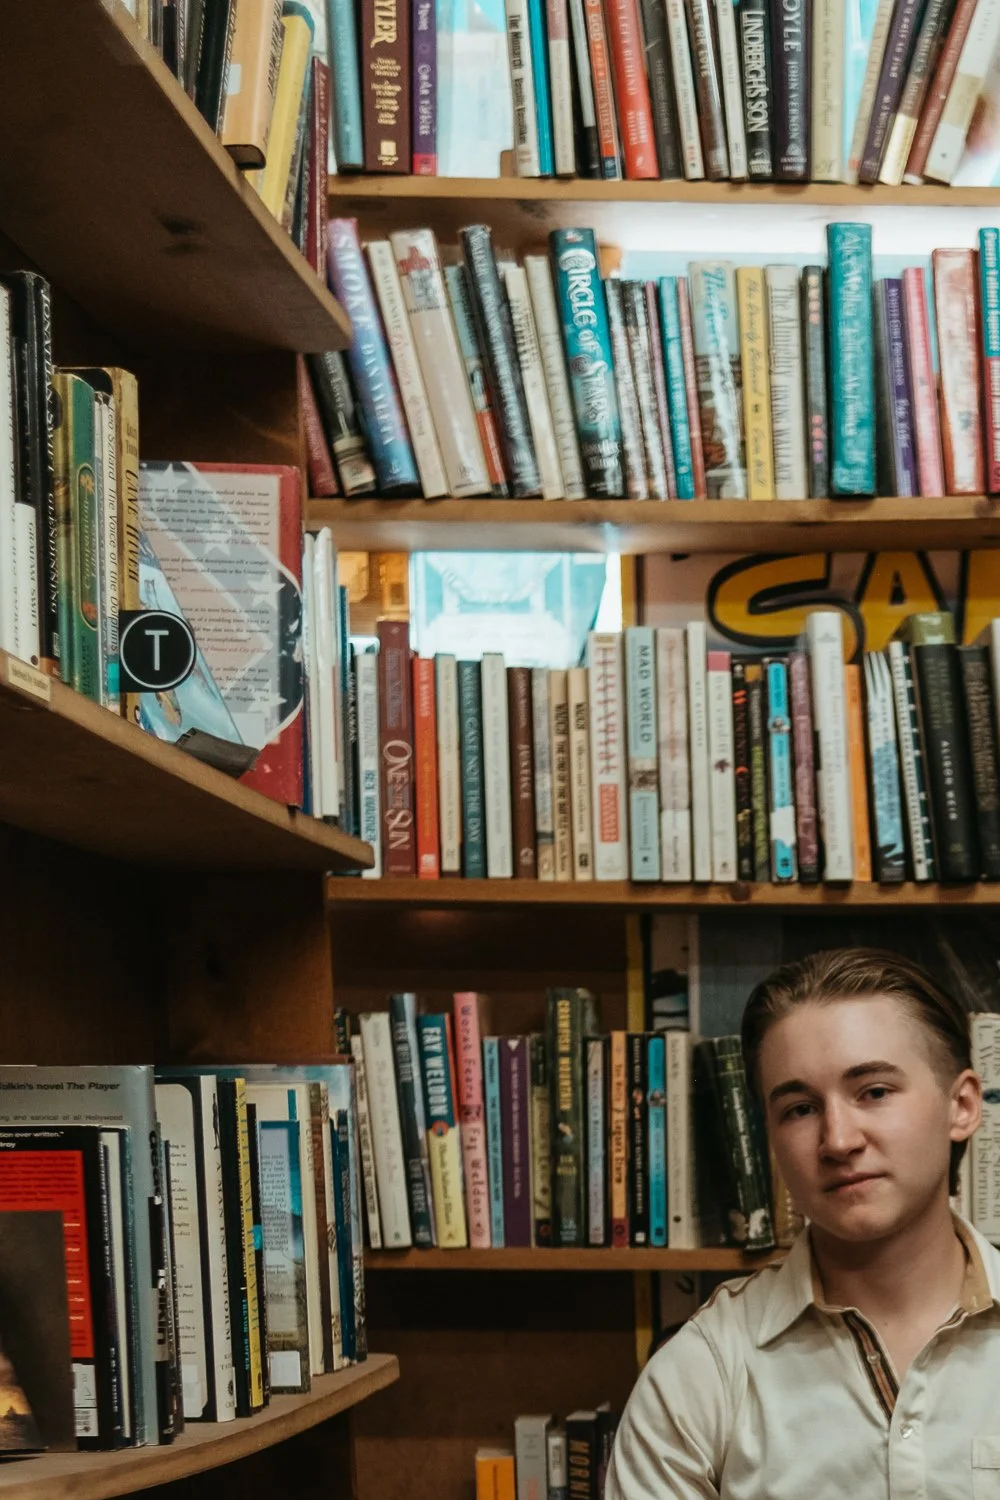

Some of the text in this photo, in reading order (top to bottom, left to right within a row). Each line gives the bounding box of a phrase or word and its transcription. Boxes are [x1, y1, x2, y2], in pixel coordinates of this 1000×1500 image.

[743, 11, 769, 132] LINDBERGH'S SON
[787, 61, 800, 90] JOHN
[788, 94, 801, 139] VERNON
[773, 285, 798, 310] The
[42, 291, 55, 474] JONATHAN SWIFT
[769, 316, 799, 378] Almighty
[106, 408, 117, 481] Leo Szilard
[773, 428, 793, 484] WALLACE
[47, 493, 58, 614] GLENDINNING
[107, 488, 121, 652] The Voice of the Dolphins
[145, 630, 169, 671] T
[638, 645, 653, 743] MAD WORLD
[383, 740, 413, 850] ONE SUN
[37, 1082, 64, 1090] novel
[89, 1082, 120, 1091] Player
[423, 1027, 448, 1116] FAY WELDON
[460, 1005, 477, 1100] Worst Fears
[465, 1128, 484, 1215] Fay Weldon
[219, 1226, 225, 1242] IN
[221, 1254, 231, 1342] UNIFORM
